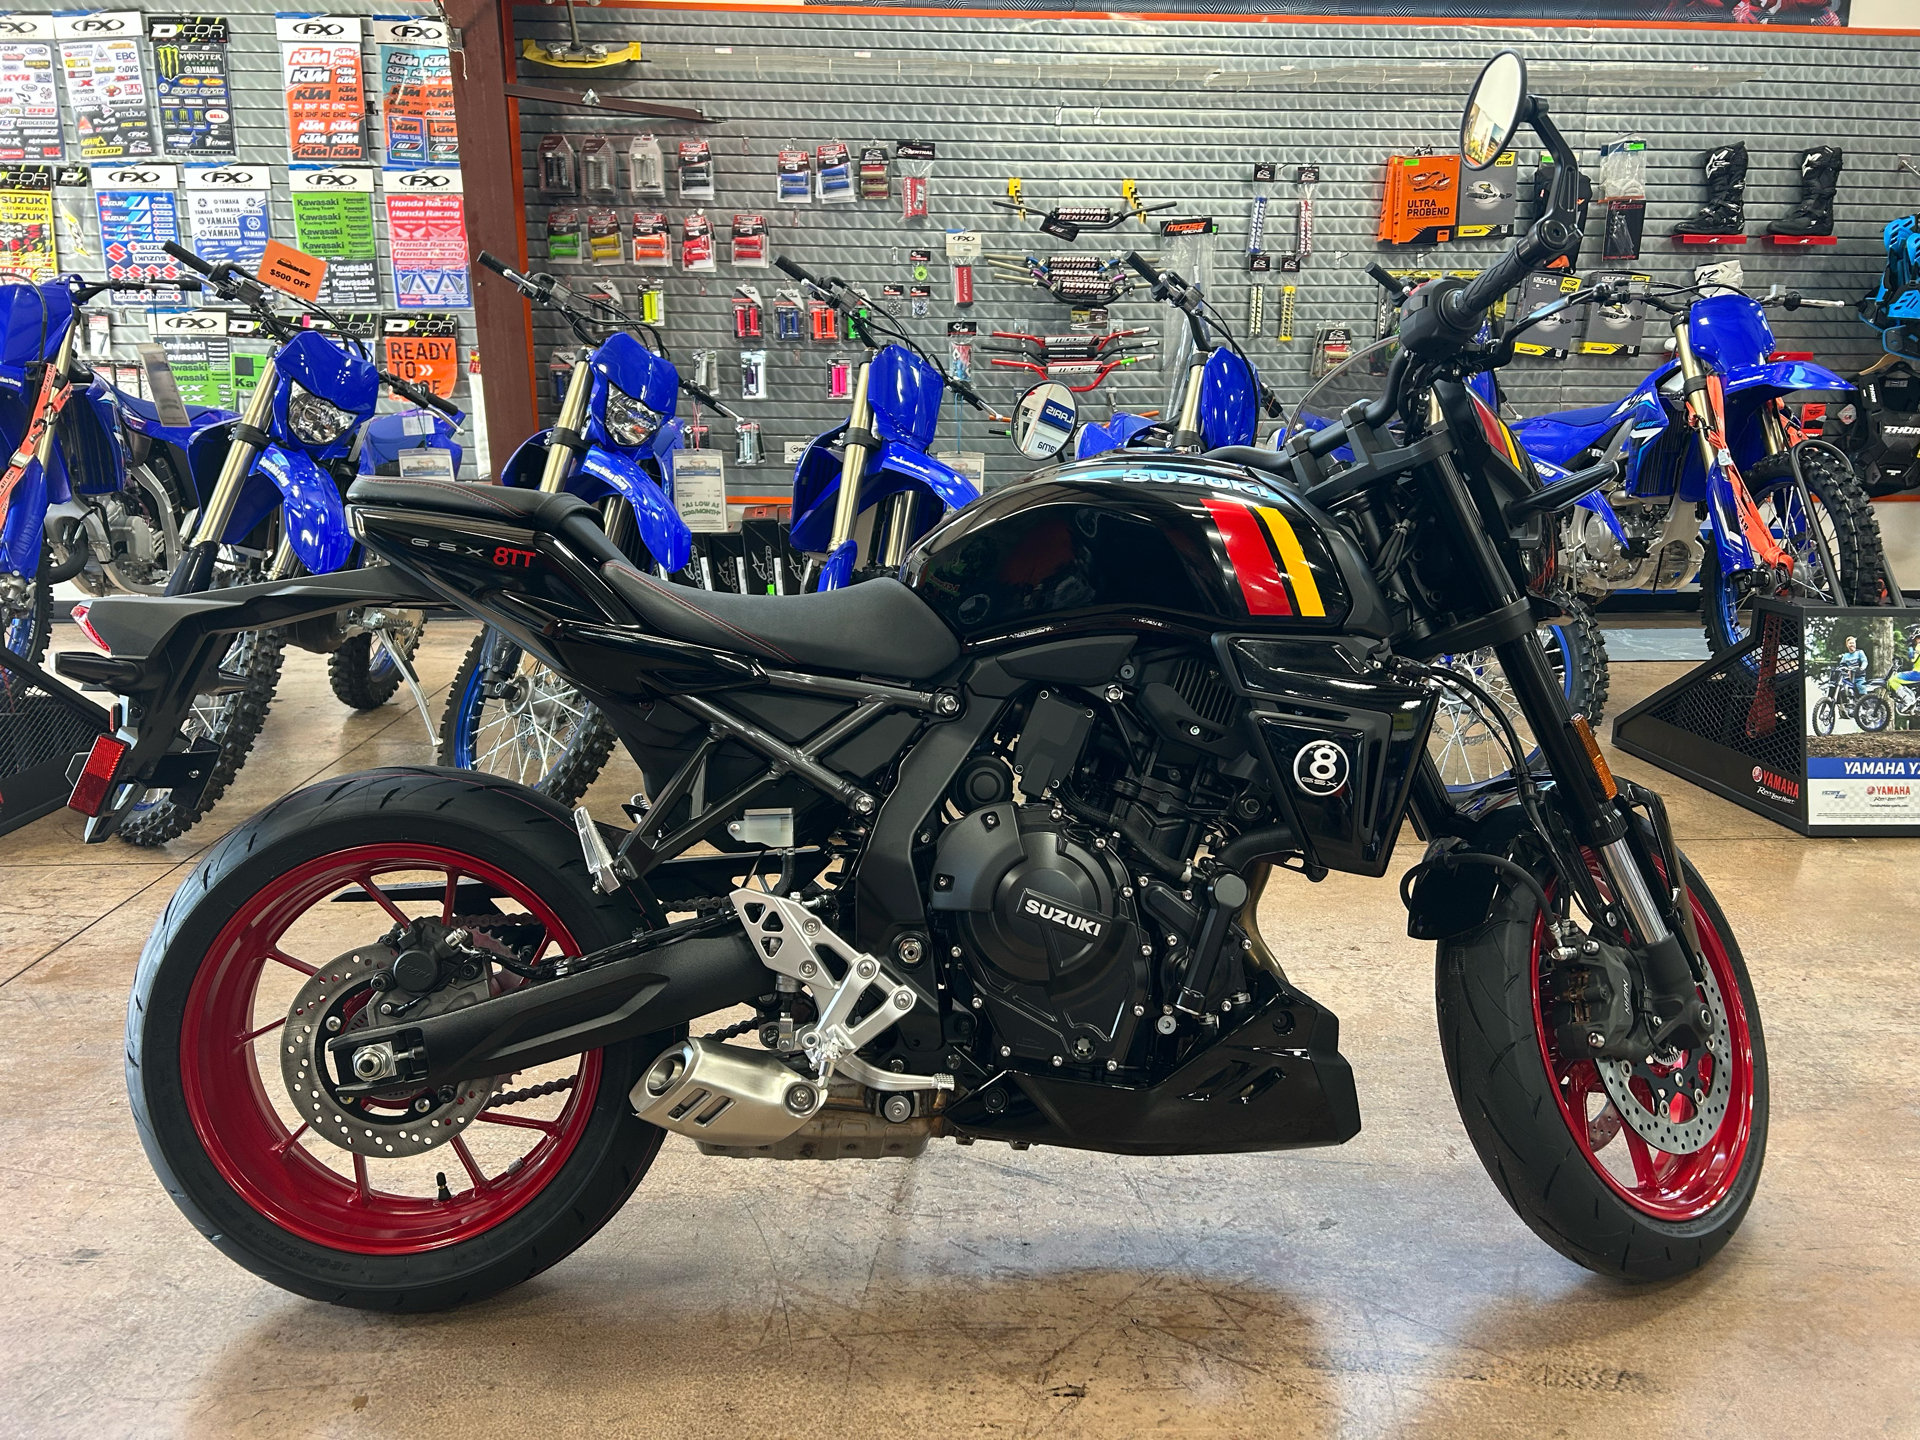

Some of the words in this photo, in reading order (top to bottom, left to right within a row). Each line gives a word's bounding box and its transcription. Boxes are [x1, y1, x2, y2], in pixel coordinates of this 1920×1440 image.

[296, 23, 341, 35] FX
[393, 25, 440, 39] FX
[116, 52, 136, 60] EBC
[291, 50, 328, 64] KTM
[389, 53, 418, 66] KTM
[293, 68, 330, 82] KTM
[388, 66, 408, 75] KTM
[337, 76, 356, 84] KTM
[295, 86, 330, 100] KTM
[298, 120, 325, 130] KTM
[330, 121, 358, 131] KTM
[396, 123, 417, 132] KTM
[299, 134, 326, 144] KTM
[331, 134, 358, 144] KTM
[300, 147, 328, 156] KTM
[332, 147, 360, 156] KTM
[110, 172, 157, 183] FX
[203, 172, 250, 183] FX
[308, 174, 354, 185] FX
[401, 175, 447, 186] FX
[1, 197, 48, 205] SUZUKI
[425, 200, 459, 208] Racing
[1408, 199, 1436, 208] ULTRA
[1407, 207, 1450, 216] PROBEND
[207, 217, 238, 225] YAMAHA
[1167, 222, 1206, 232] MOOSE
[430, 242, 463, 250] Racing
[330, 264, 373, 272] Kawasaki
[270, 269, 292, 282] $500
[294, 279, 310, 288] OFF
[332, 278, 375, 286] Kawasaki
[391, 342, 452, 360] READY
[392, 361, 416, 379] TO
[1869, 384, 1877, 402] THOR
[1884, 426, 1920, 434] THOR
[1122, 470, 1268, 498] SUZUKI
[493, 546, 536, 568] 8TT
[1310, 747, 1338, 780] 8
[1844, 762, 1905, 774] YAMAHA
[1763, 770, 1798, 799] YAMAHA
[1876, 786, 1910, 795] YAMAHA
[1024, 899, 1102, 937] SUZUKI
